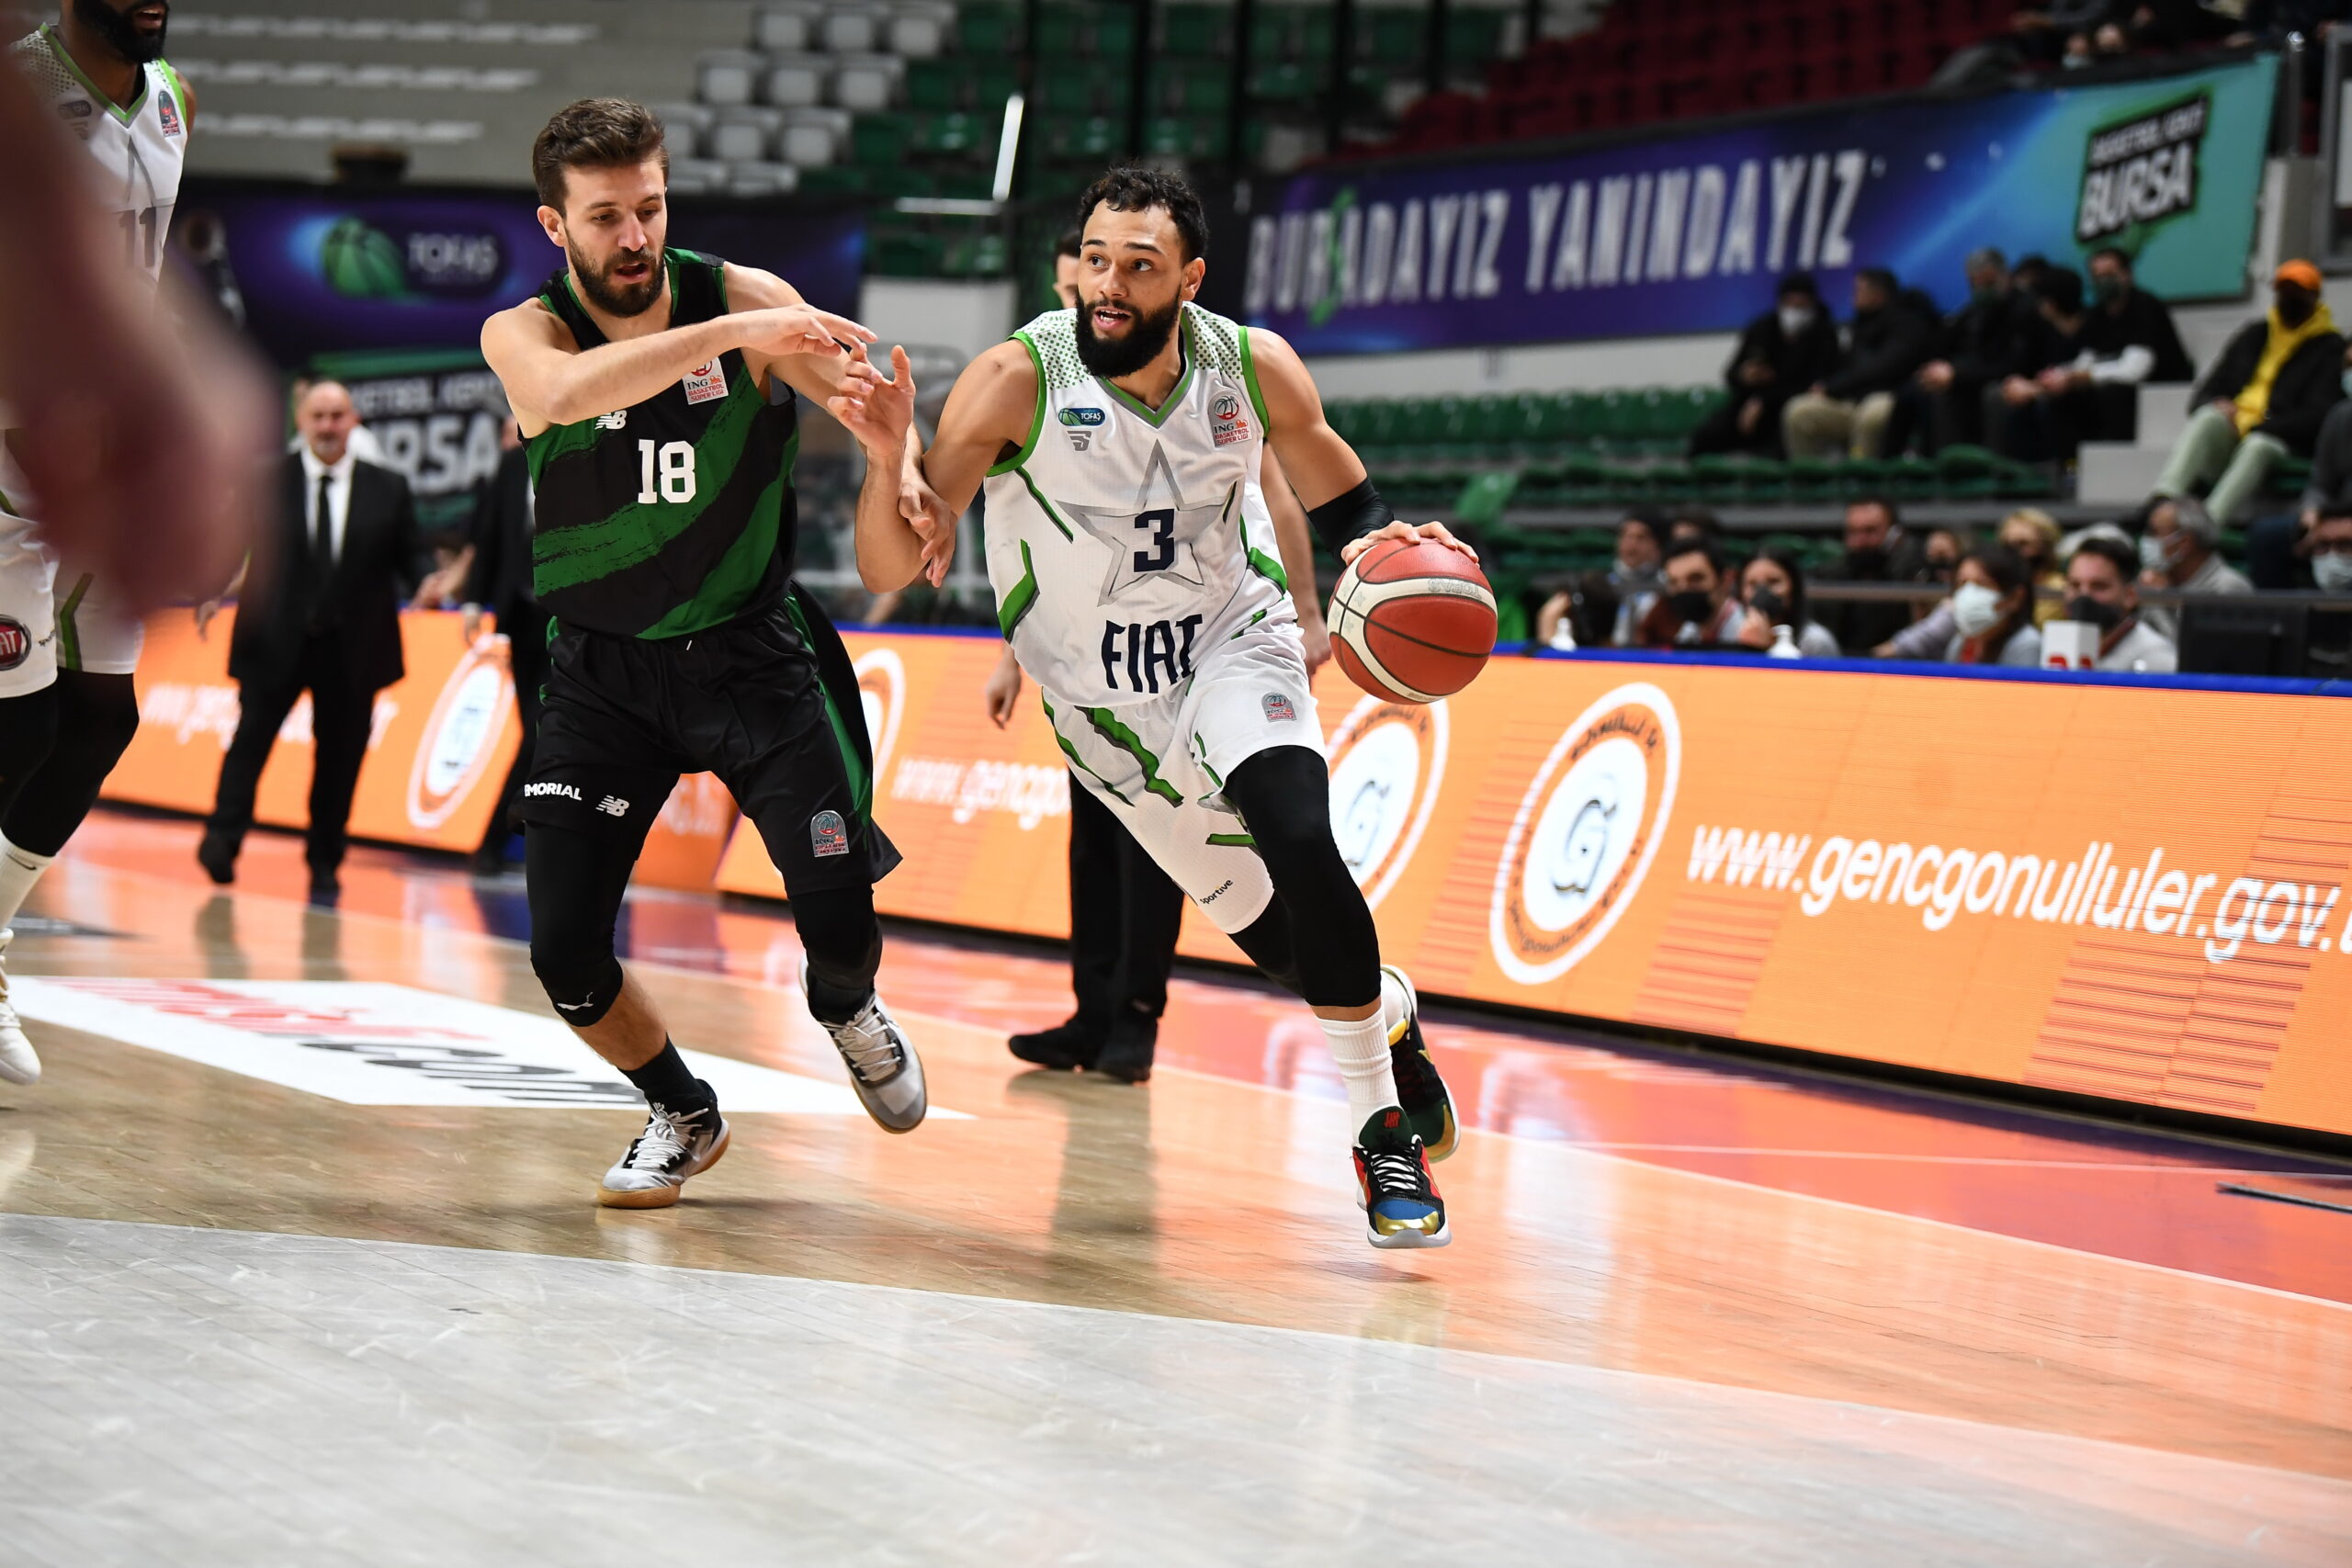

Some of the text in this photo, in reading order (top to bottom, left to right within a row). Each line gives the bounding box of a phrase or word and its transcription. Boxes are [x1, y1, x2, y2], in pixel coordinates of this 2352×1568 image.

[2078, 141, 2193, 237] BURSA
[119, 208, 157, 269] 11
[1525, 150, 1867, 294] YANINDAYIZ
[687, 378, 707, 389] ING
[688, 384, 724, 396] BASKETBOL
[1214, 423, 1234, 434] ING
[1215, 428, 1250, 439] BASKETBOL
[638, 439, 696, 503] 18
[1134, 508, 1174, 572] 3
[0, 630, 17, 655] AT
[1102, 614, 1203, 694] FIAT
